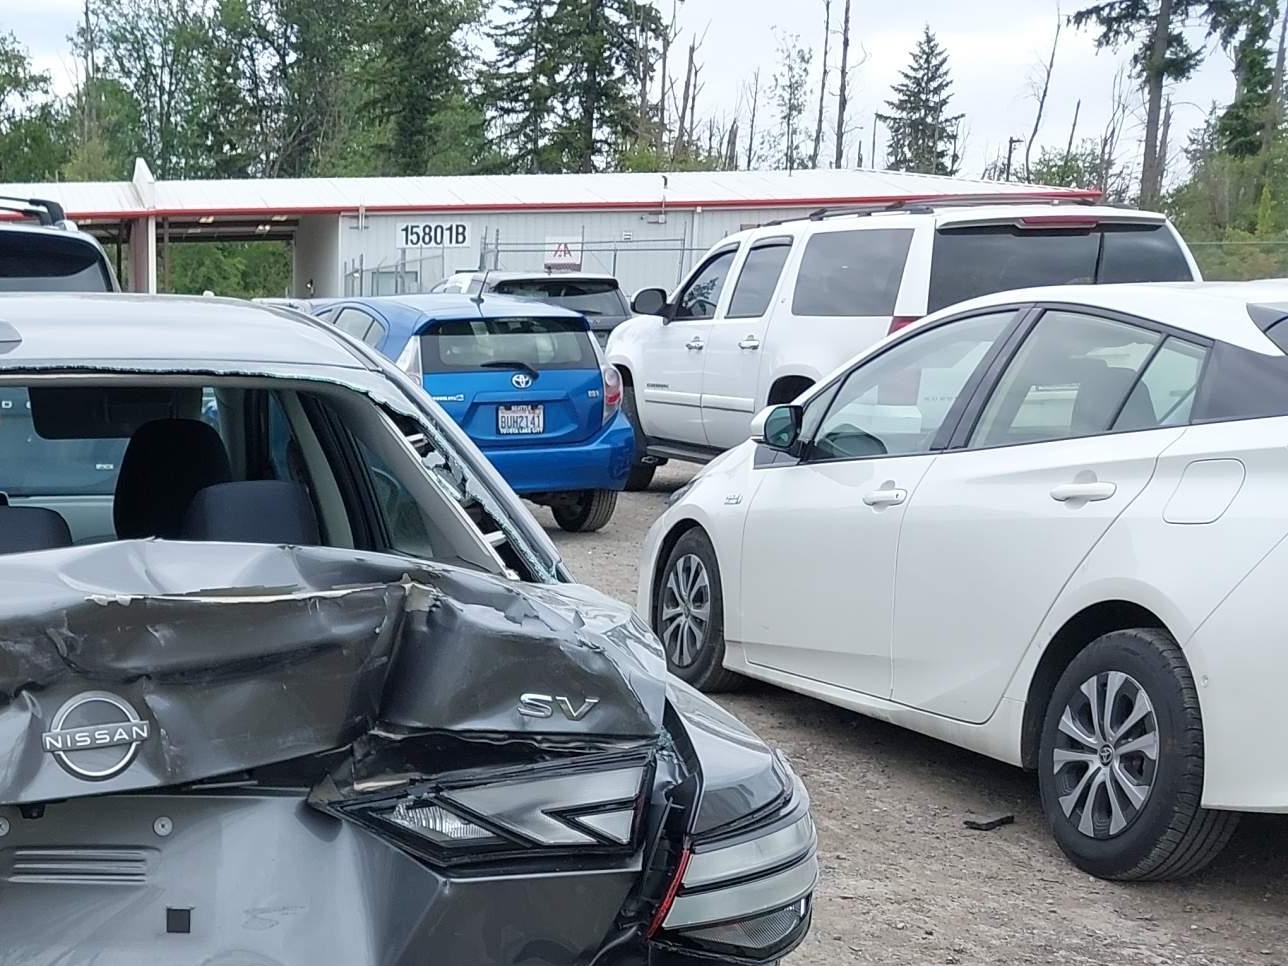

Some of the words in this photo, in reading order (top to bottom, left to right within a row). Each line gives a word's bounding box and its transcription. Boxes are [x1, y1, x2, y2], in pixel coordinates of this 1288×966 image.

[401, 224, 467, 245] 15801B
[500, 415, 541, 429] BUH2141
[518, 693, 600, 722] SV
[45, 724, 148, 750] NISSAN
